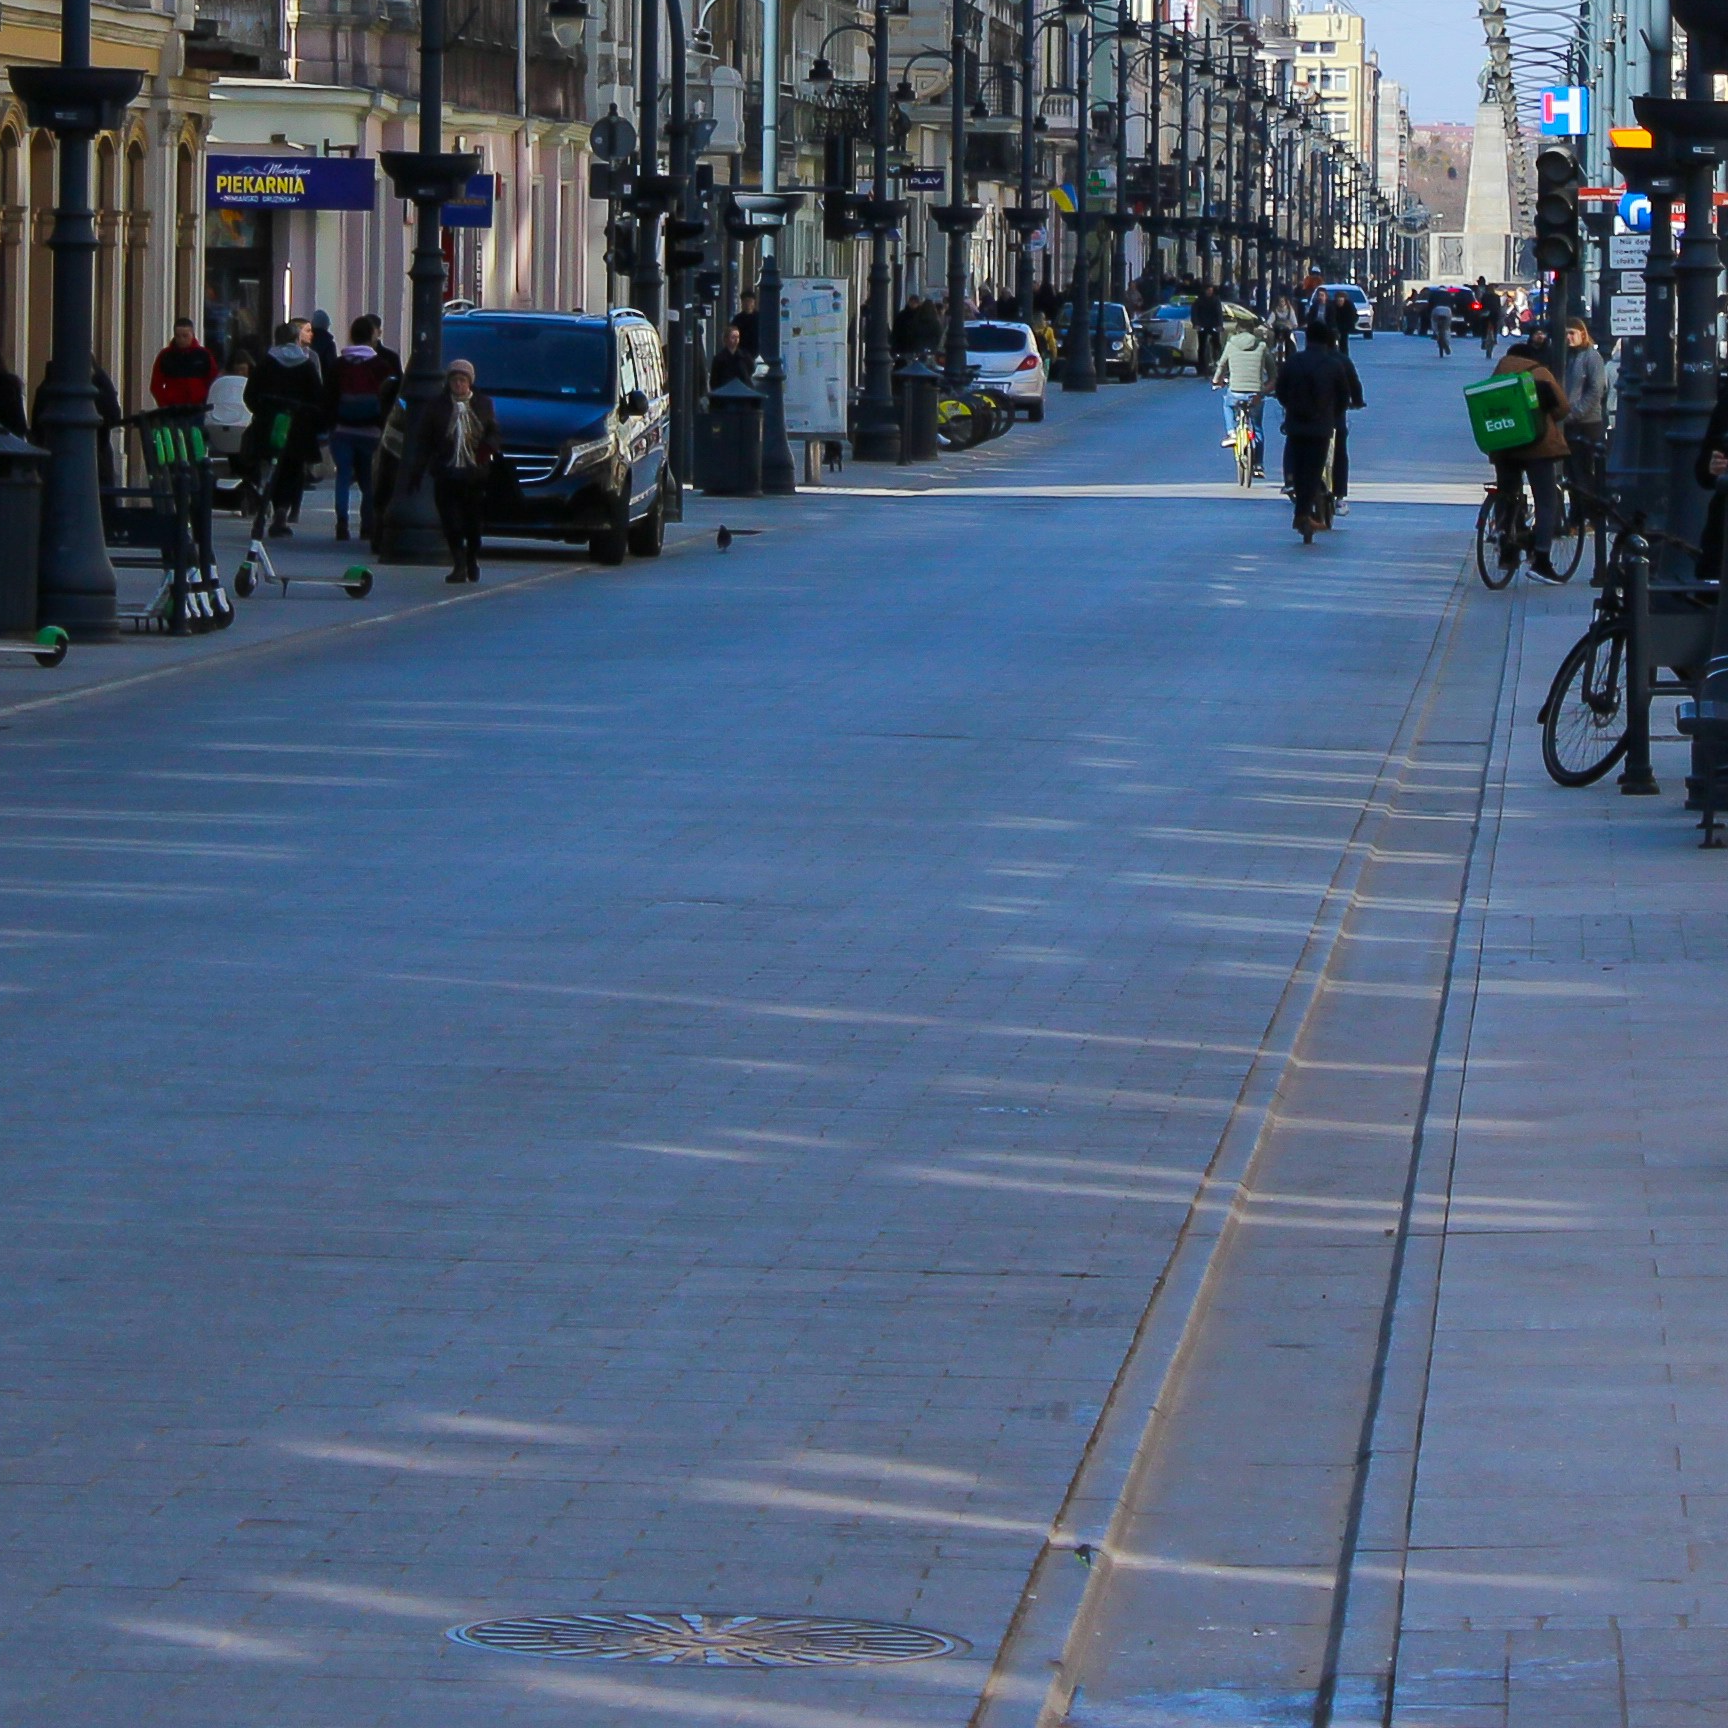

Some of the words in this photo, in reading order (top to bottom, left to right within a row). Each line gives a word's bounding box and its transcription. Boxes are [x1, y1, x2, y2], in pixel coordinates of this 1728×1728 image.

[216, 175, 305, 194] PIEKARNIA
[910, 176, 941, 186] PLAY
[1485, 418, 1516, 432] Eats
